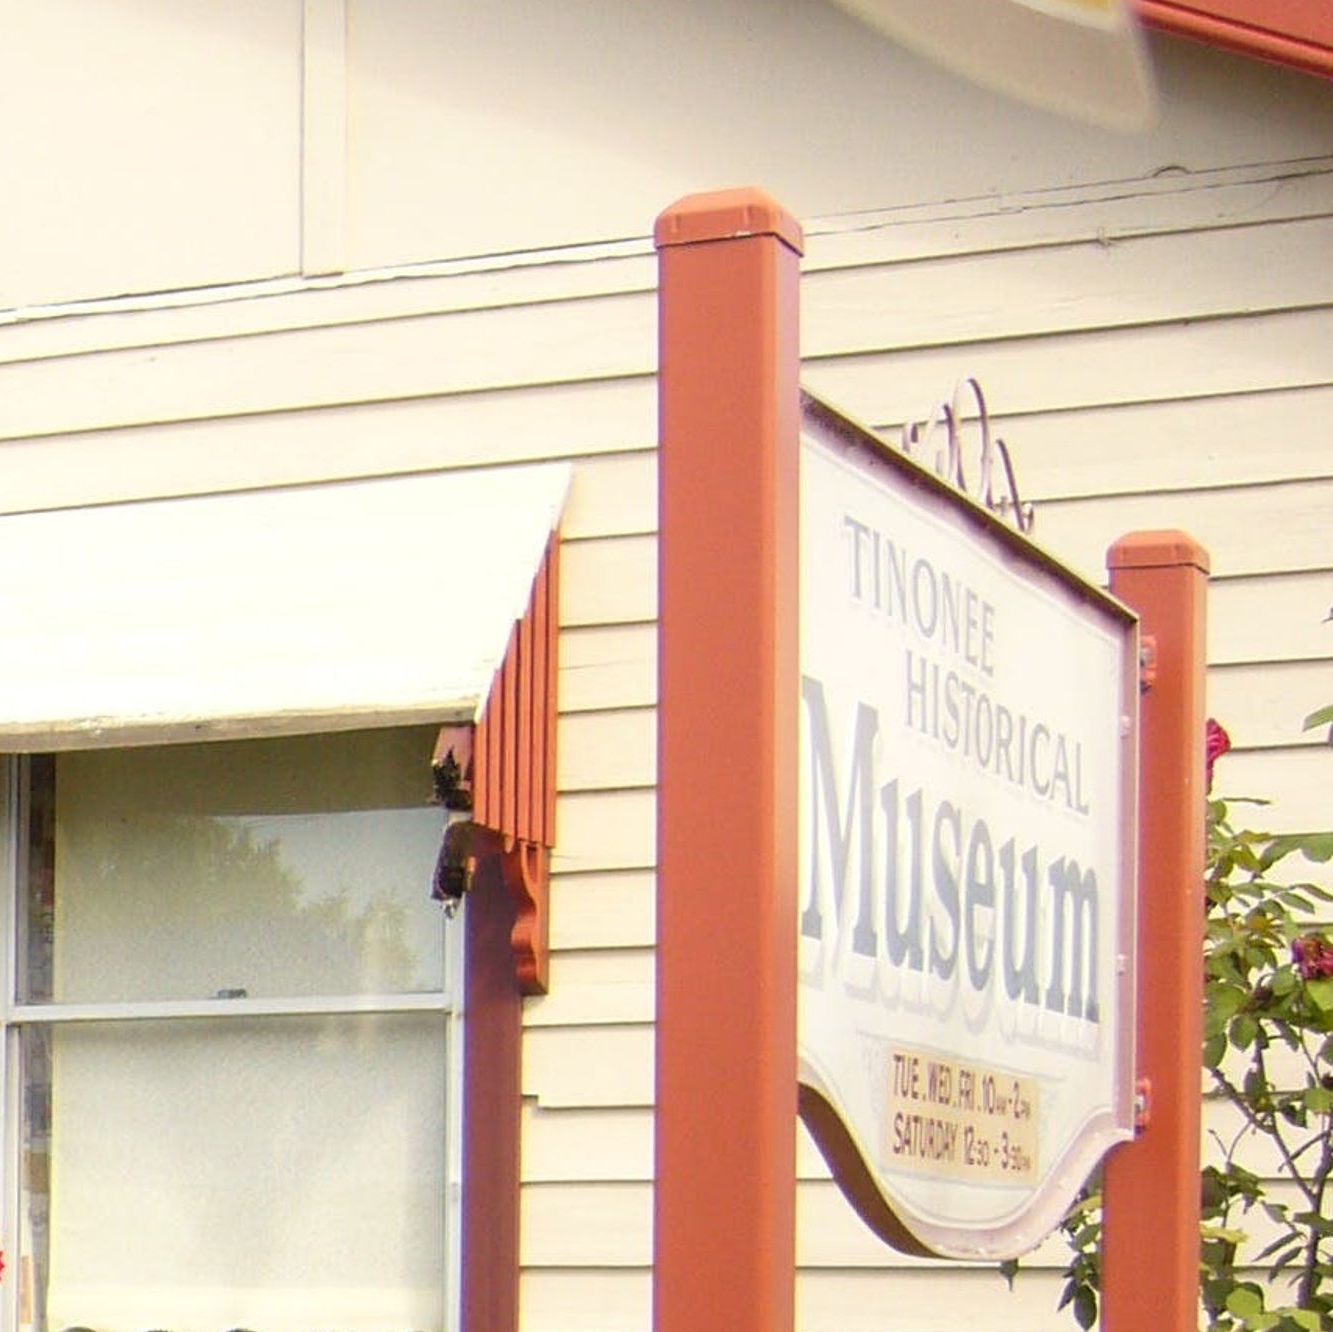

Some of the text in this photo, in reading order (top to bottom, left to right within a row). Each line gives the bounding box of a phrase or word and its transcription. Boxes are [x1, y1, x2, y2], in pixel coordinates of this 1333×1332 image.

[843, 515, 995, 678] TINONEE
[905, 649, 1089, 816] HISTORICAL
[801, 674, 1100, 1024] Museum
[893, 1111, 959, 1161] SATURDAY
